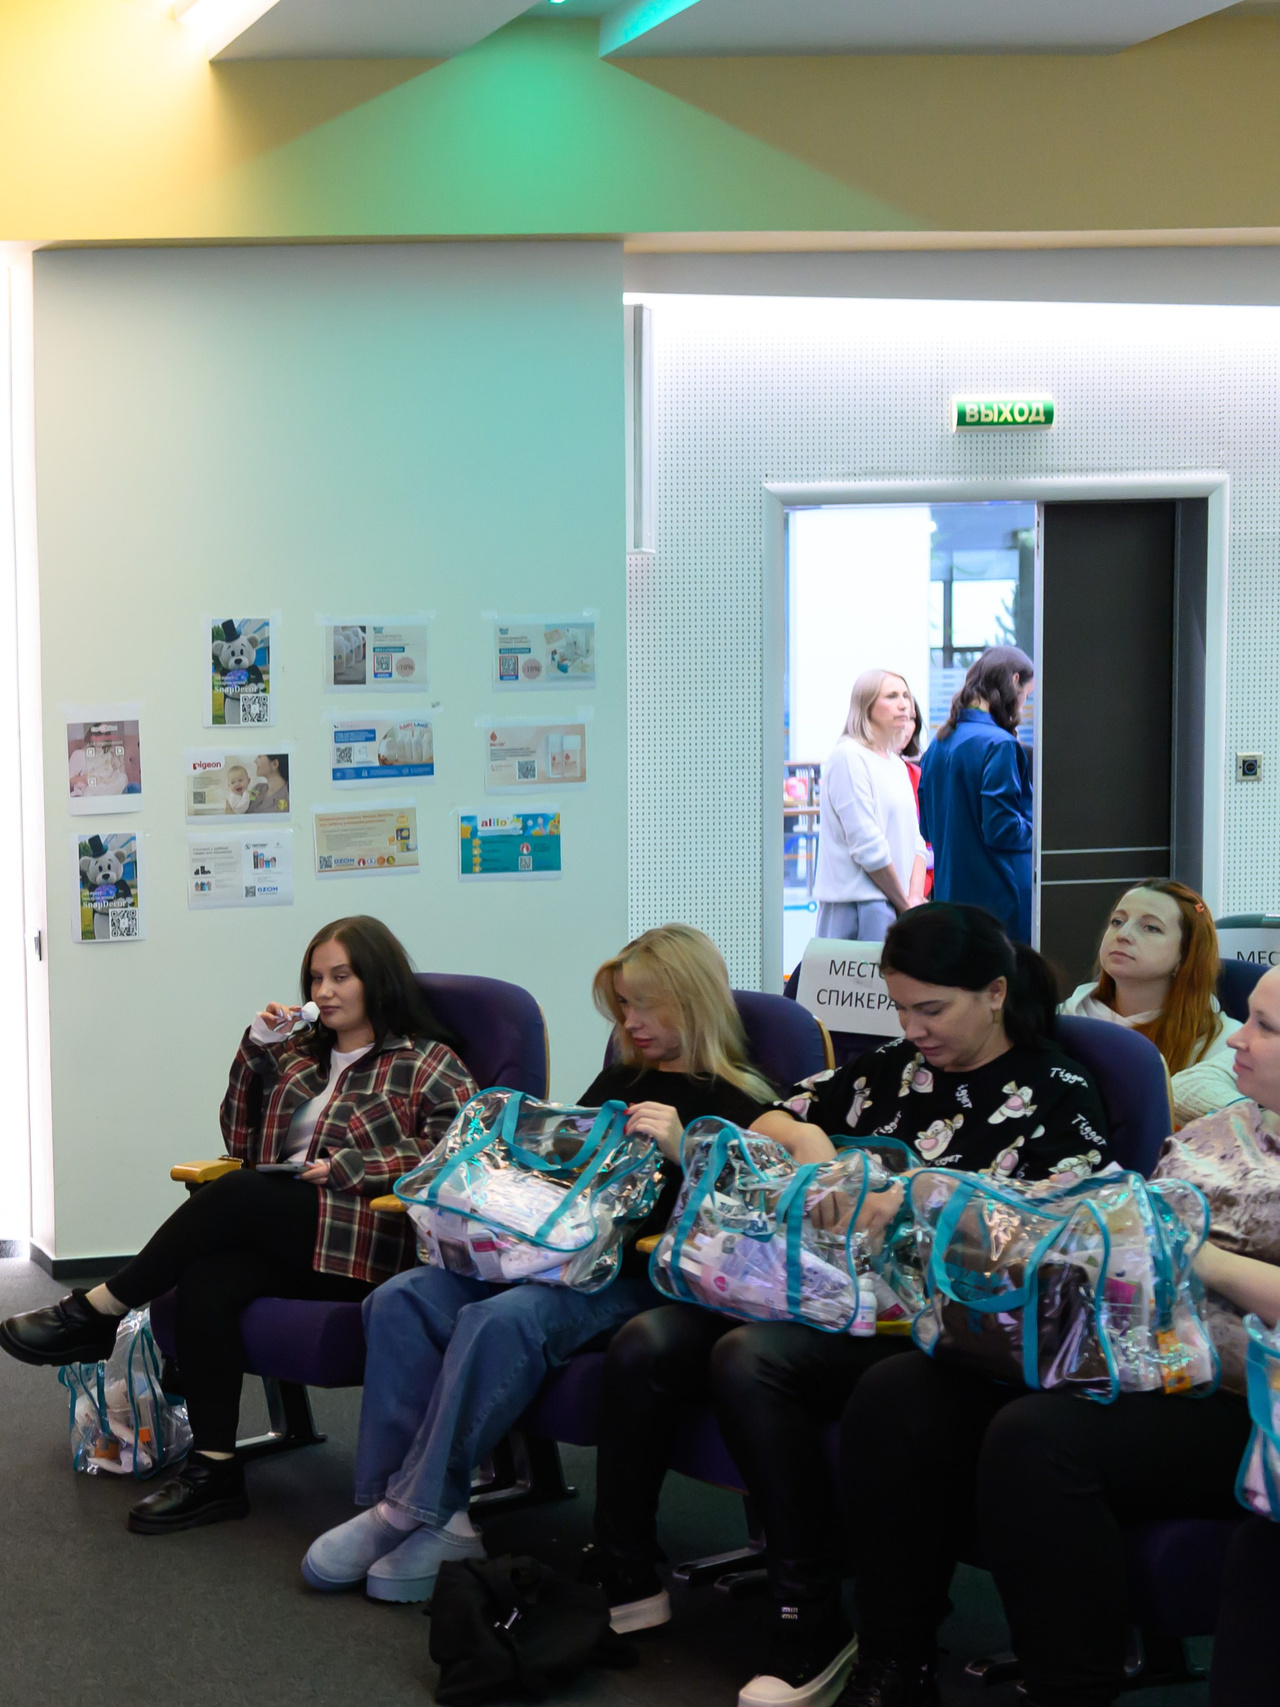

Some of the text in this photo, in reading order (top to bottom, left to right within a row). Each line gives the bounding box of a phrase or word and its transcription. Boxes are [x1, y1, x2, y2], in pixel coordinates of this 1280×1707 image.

[964, 402, 1046, 424] ВЫХОД
[214, 685, 259, 695] SnapDecor
[192, 760, 222, 771] pigeon
[481, 818, 507, 828] alilo
[82, 900, 127, 911] SnapDecor
[816, 988, 899, 1011] СПИКЕРА
[1071, 1113, 1107, 1146] Tigger
